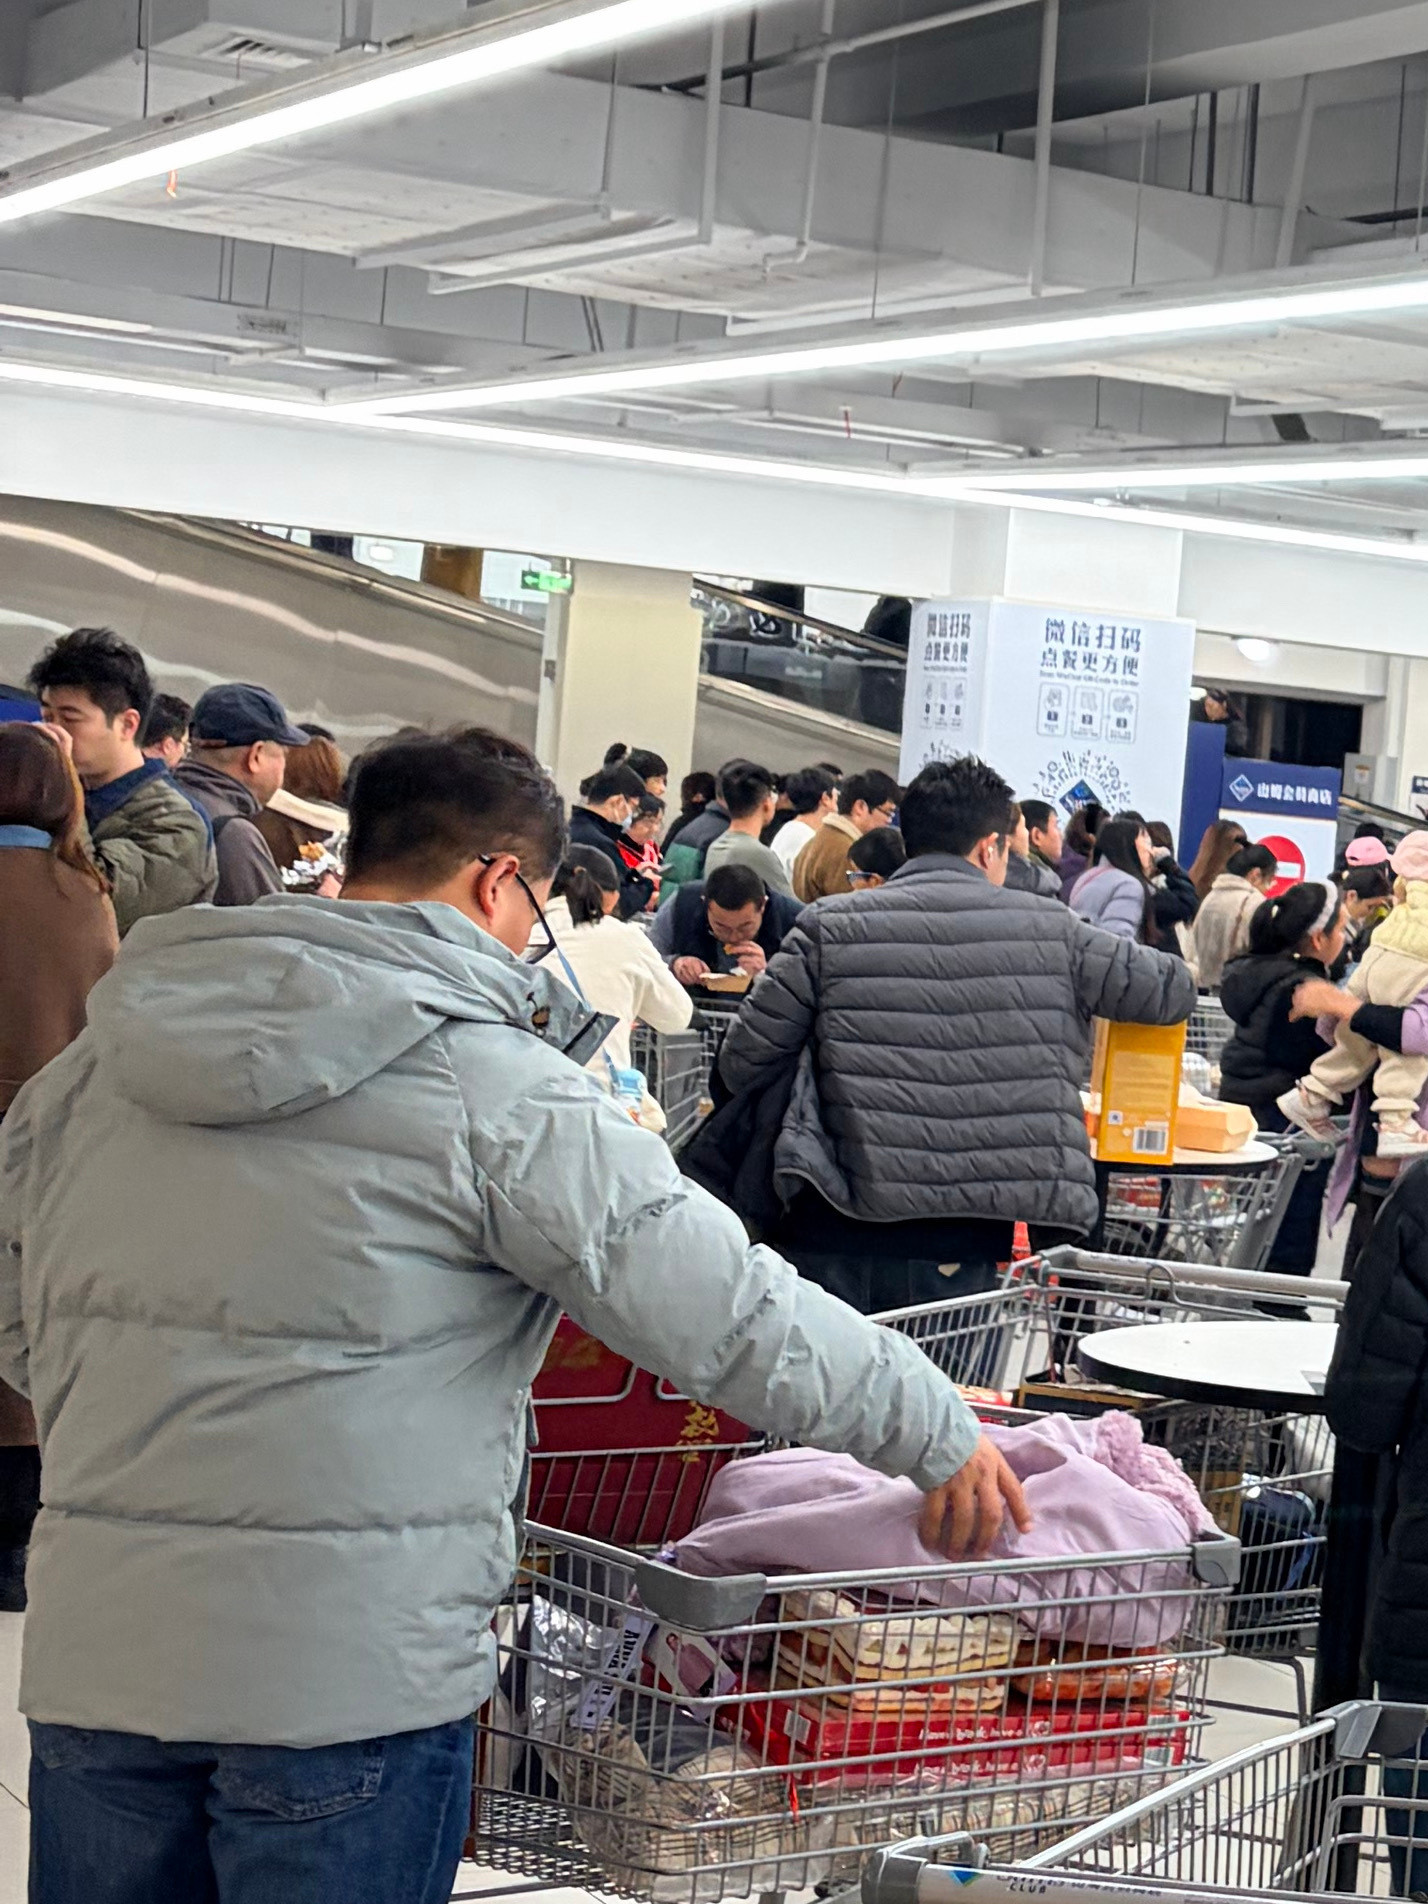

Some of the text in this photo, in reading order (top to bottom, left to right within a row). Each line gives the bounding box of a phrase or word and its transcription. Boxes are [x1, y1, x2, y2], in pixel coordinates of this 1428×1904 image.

[1045, 618, 1140, 653] 微信扫码
[1041, 647, 1139, 676] 点餐更方便
[1010, 1882, 1046, 1894] CLUB
